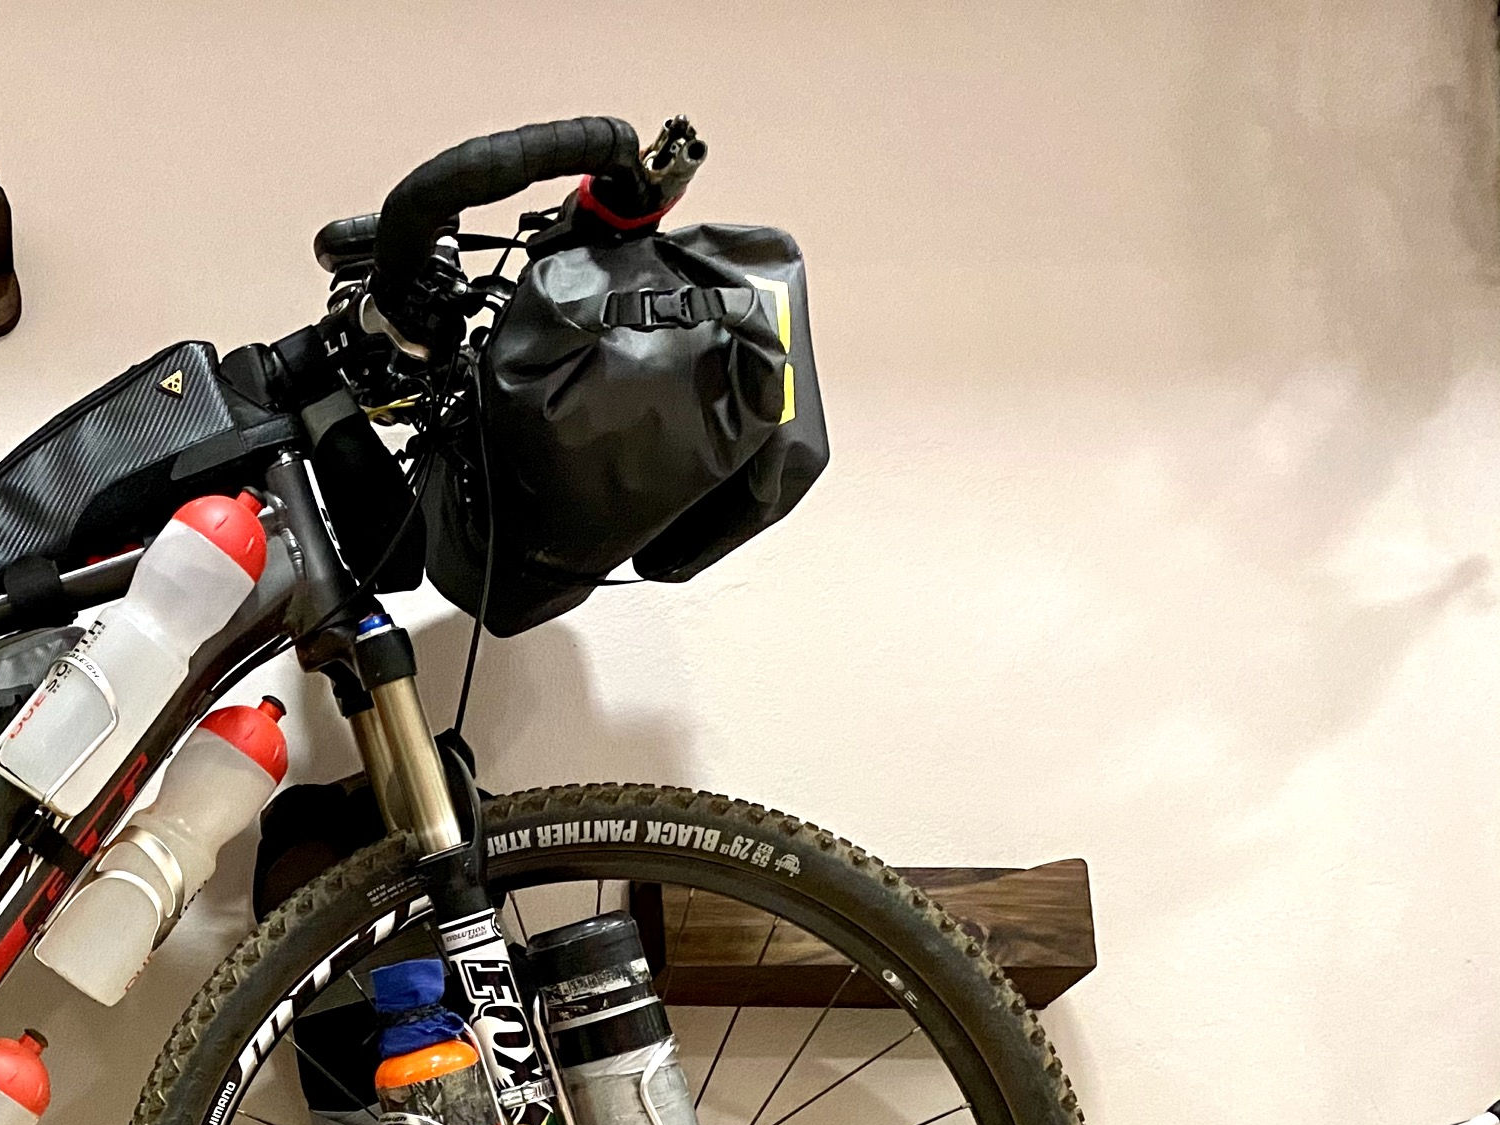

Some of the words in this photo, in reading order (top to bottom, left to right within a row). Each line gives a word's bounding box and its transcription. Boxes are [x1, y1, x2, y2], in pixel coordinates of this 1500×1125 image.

[537, 819, 639, 849] PANTHER
[644, 820, 722, 853] BLACK
[462, 960, 544, 1088] FOX
